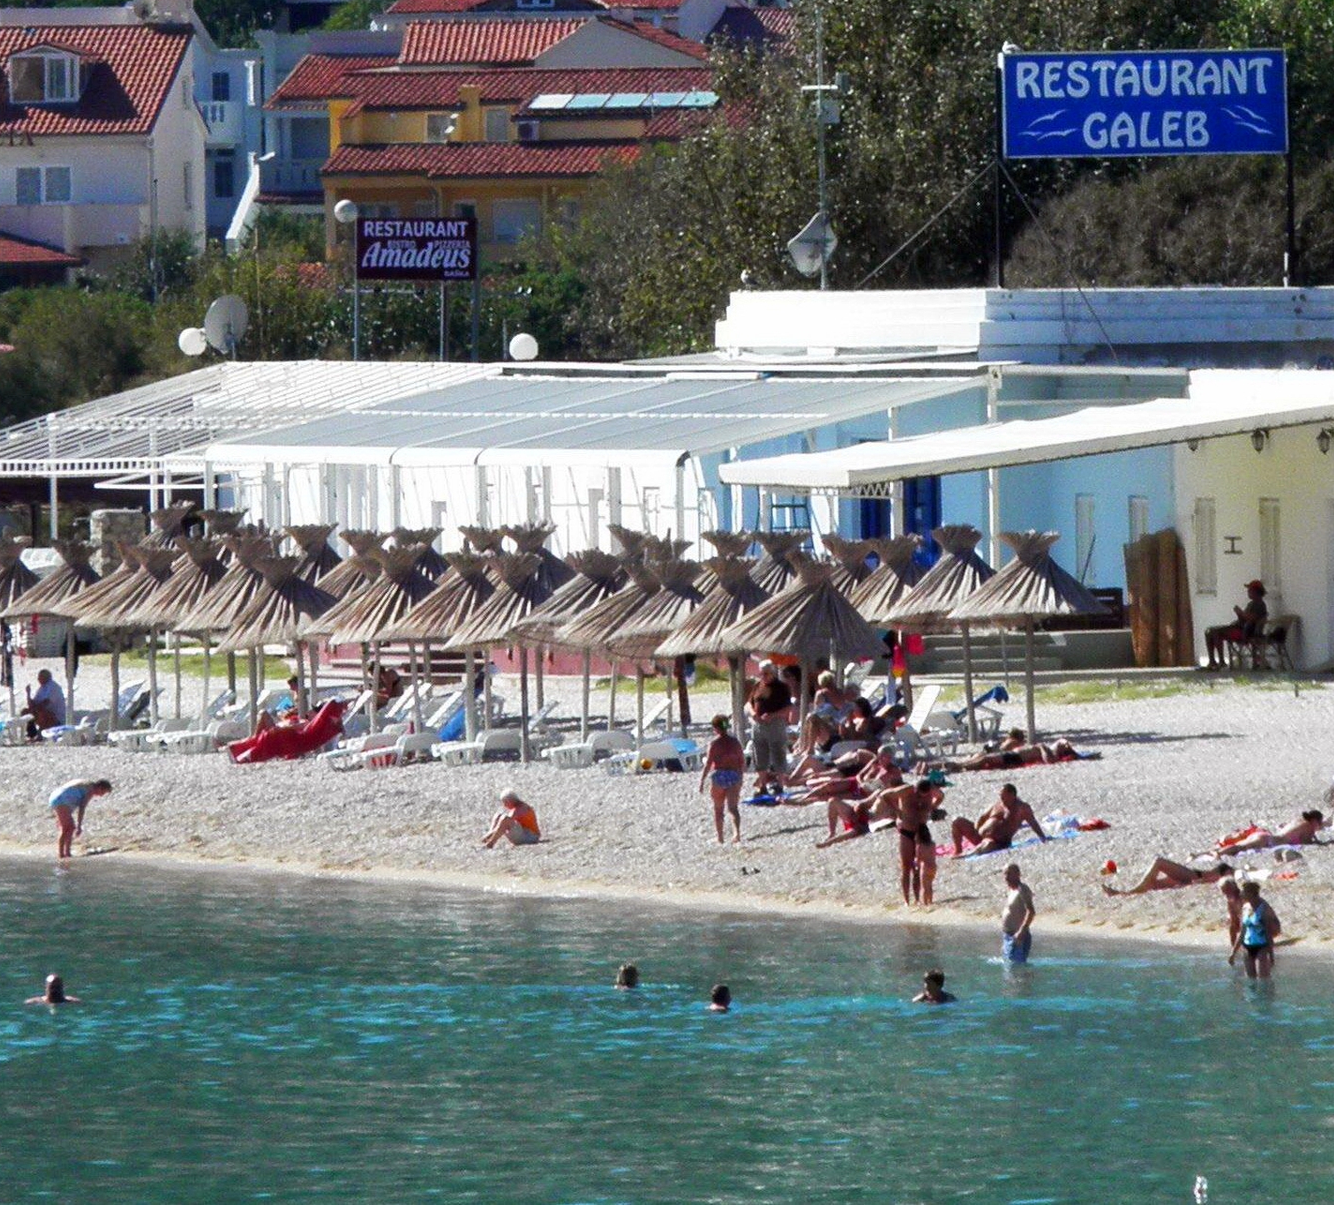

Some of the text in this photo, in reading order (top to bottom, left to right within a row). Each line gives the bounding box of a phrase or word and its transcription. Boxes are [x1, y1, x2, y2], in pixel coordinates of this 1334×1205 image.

[1017, 57, 1273, 99] RESTAURANT
[1082, 110, 1210, 149] GALEB
[364, 221, 469, 238] RESTAURANT
[361, 241, 471, 268] Amadeus
